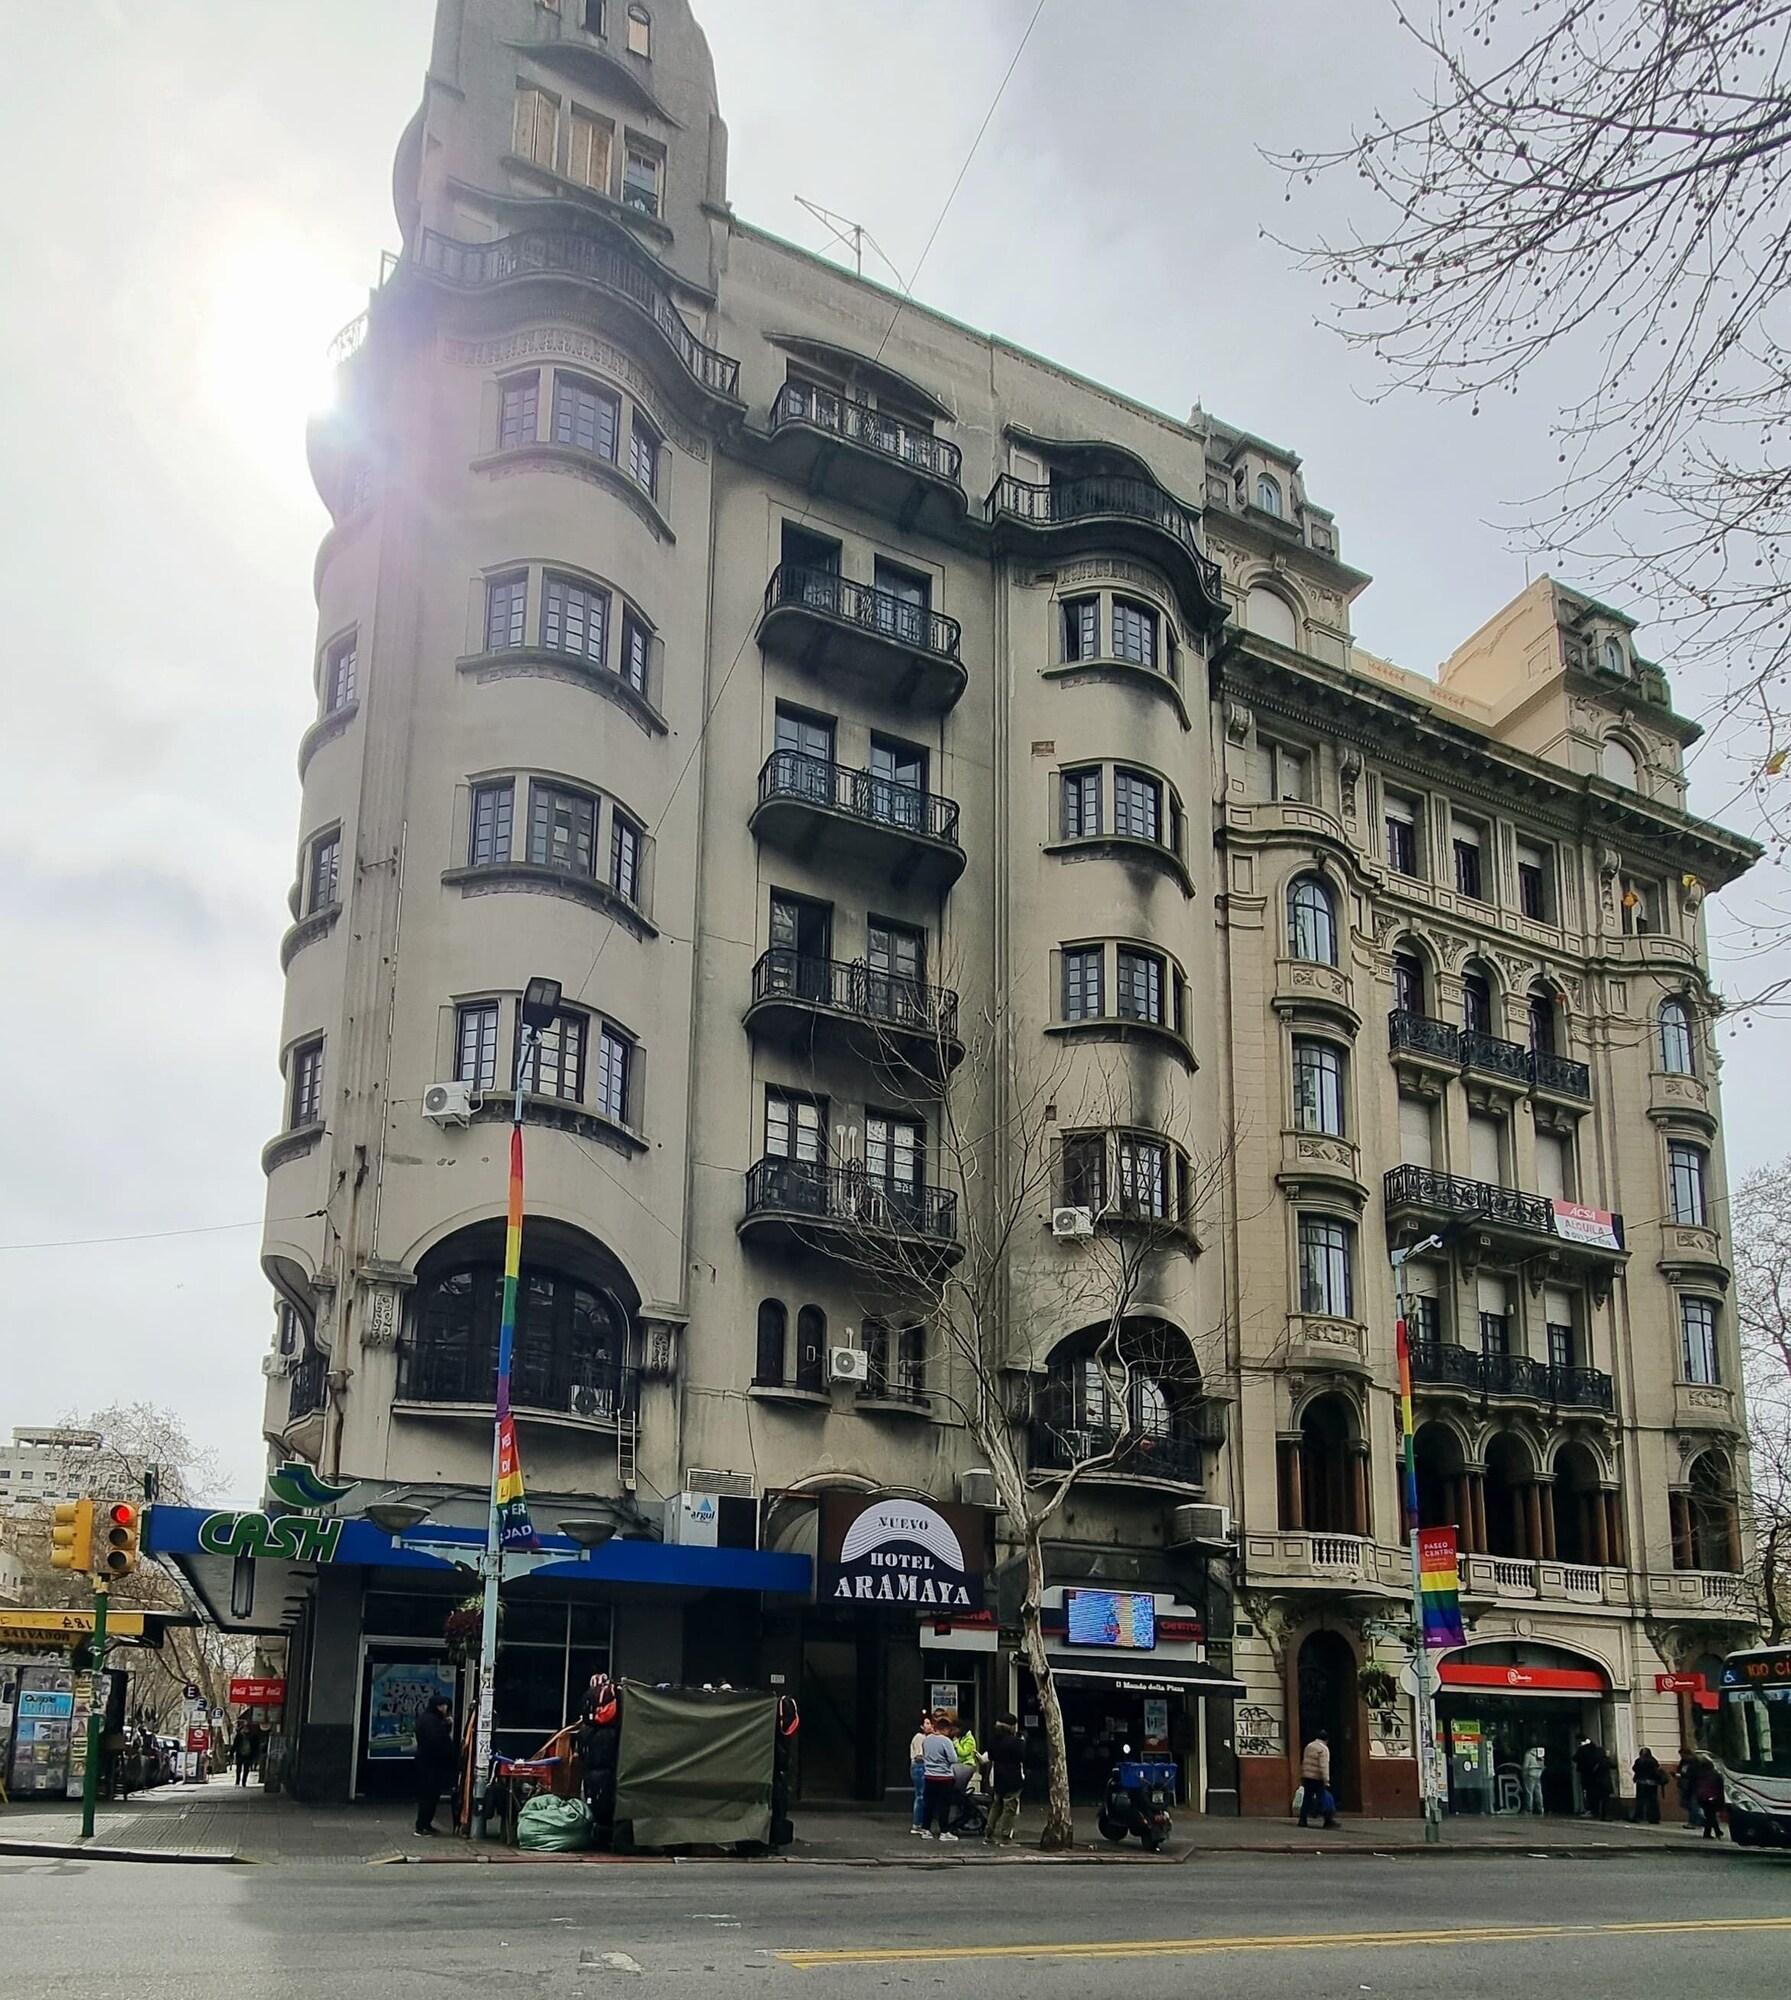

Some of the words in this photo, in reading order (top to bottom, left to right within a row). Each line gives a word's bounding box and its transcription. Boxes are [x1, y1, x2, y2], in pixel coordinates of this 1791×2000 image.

[1569, 1206, 1596, 1220] ACSA
[1565, 1219, 1605, 1235] ALQUILA
[878, 1516, 929, 1531] NUEVO
[198, 1511, 344, 1563] CASH
[1424, 1541, 1449, 1550] PASEO
[1424, 1548, 1454, 1558] CENTRO
[870, 1552, 935, 1570] HOTEL
[833, 1573, 971, 1605] ARAMAYA
[3, 1629, 70, 1641] SALVADOR
[1746, 1662, 1769, 1677] 100
[187, 1687, 196, 1697] E
